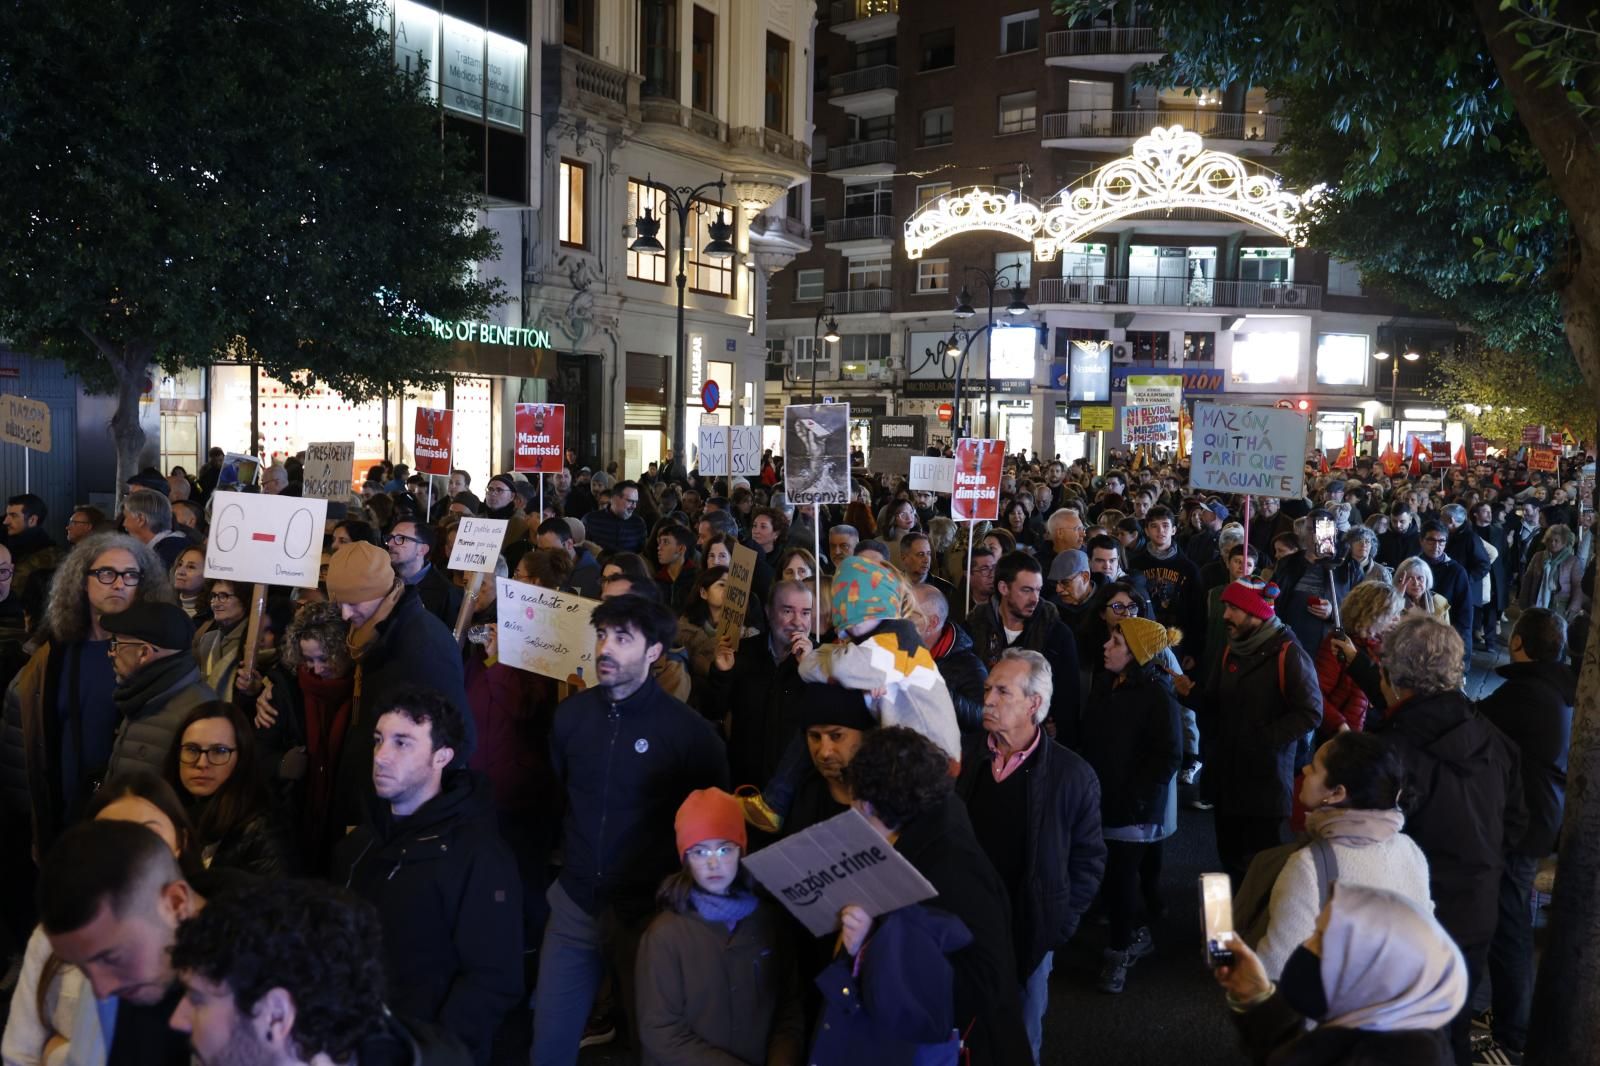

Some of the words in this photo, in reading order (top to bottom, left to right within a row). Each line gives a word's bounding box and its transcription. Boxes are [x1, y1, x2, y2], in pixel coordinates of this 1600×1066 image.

[456, 321, 478, 342] OF
[416, 433, 439, 447] Mazón
[519, 431, 550, 444] Mazón
[415, 446, 449, 460] dimissió
[517, 445, 560, 457] dimissió
[1249, 453, 1288, 471] QUE
[956, 472, 987, 485] Mazón
[955, 486, 996, 499] dimissió
[216, 503, 245, 553] 6
[284, 508, 314, 560] 0
[781, 870, 834, 902] mazón
[831, 845, 888, 880] crime
